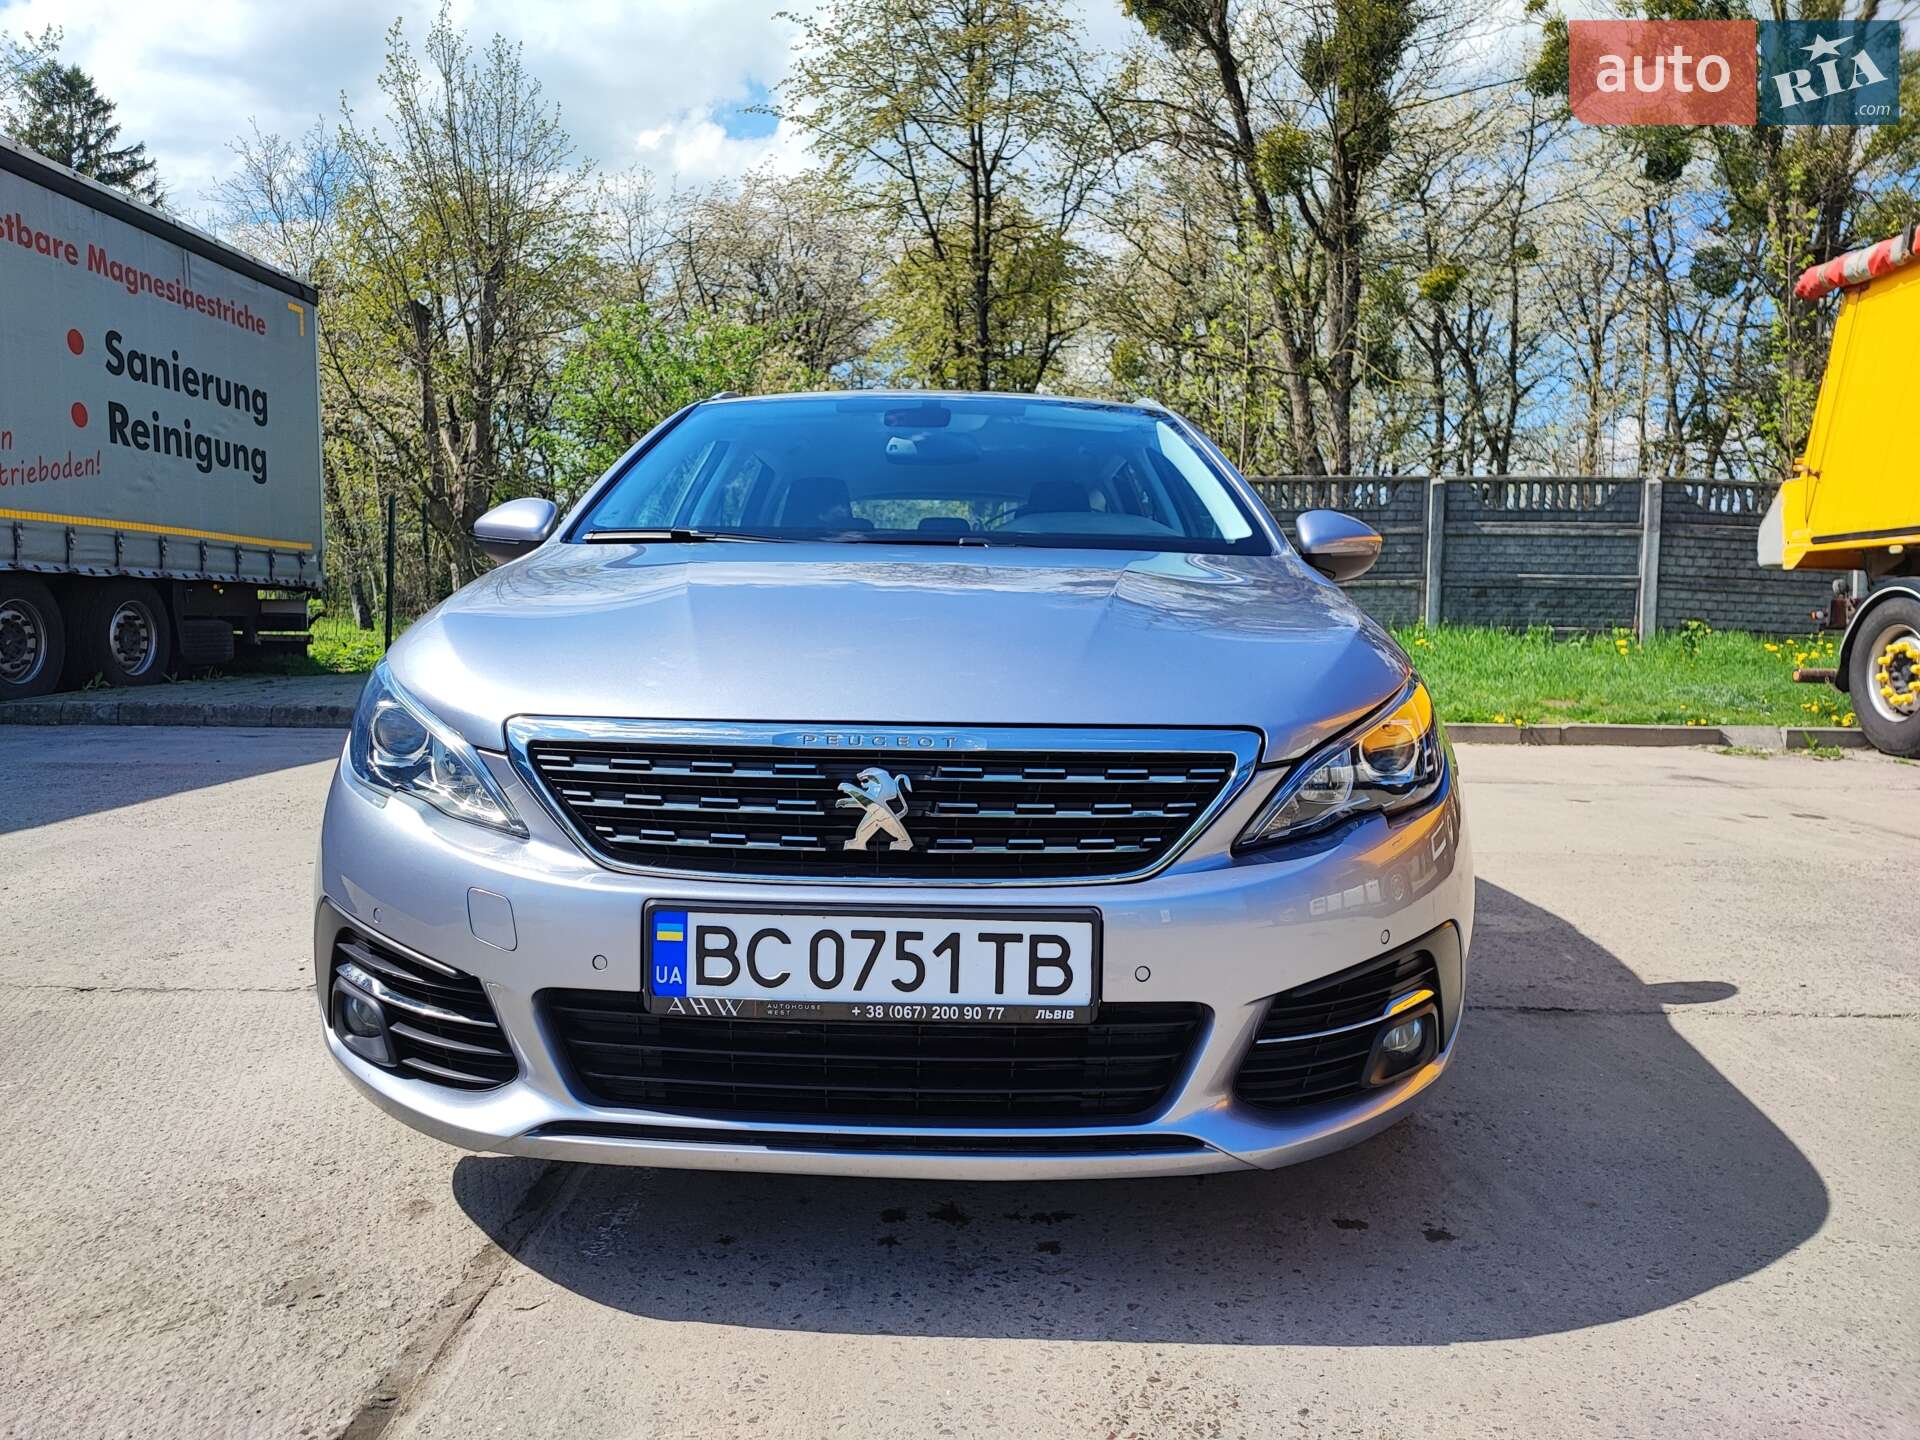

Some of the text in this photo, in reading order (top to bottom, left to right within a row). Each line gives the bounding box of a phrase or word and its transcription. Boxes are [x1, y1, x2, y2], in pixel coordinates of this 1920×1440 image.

[105, 330, 268, 427] Sanierung
[108, 401, 267, 484] Reinigung
[802, 734, 957, 748] PEUGEOT
[696, 926, 1074, 996] BC 0751 TB
[655, 966, 683, 985] UA
[666, 997, 744, 1017] AHW
[767, 1003, 822, 1011] AUTOHOUSE
[865, 1005, 884, 1018] 38
[888, 1005, 927, 1020] (067)
[931, 1007, 959, 1020] 200
[963, 1008, 982, 1020] 90
[986, 1007, 1005, 1020] 77
